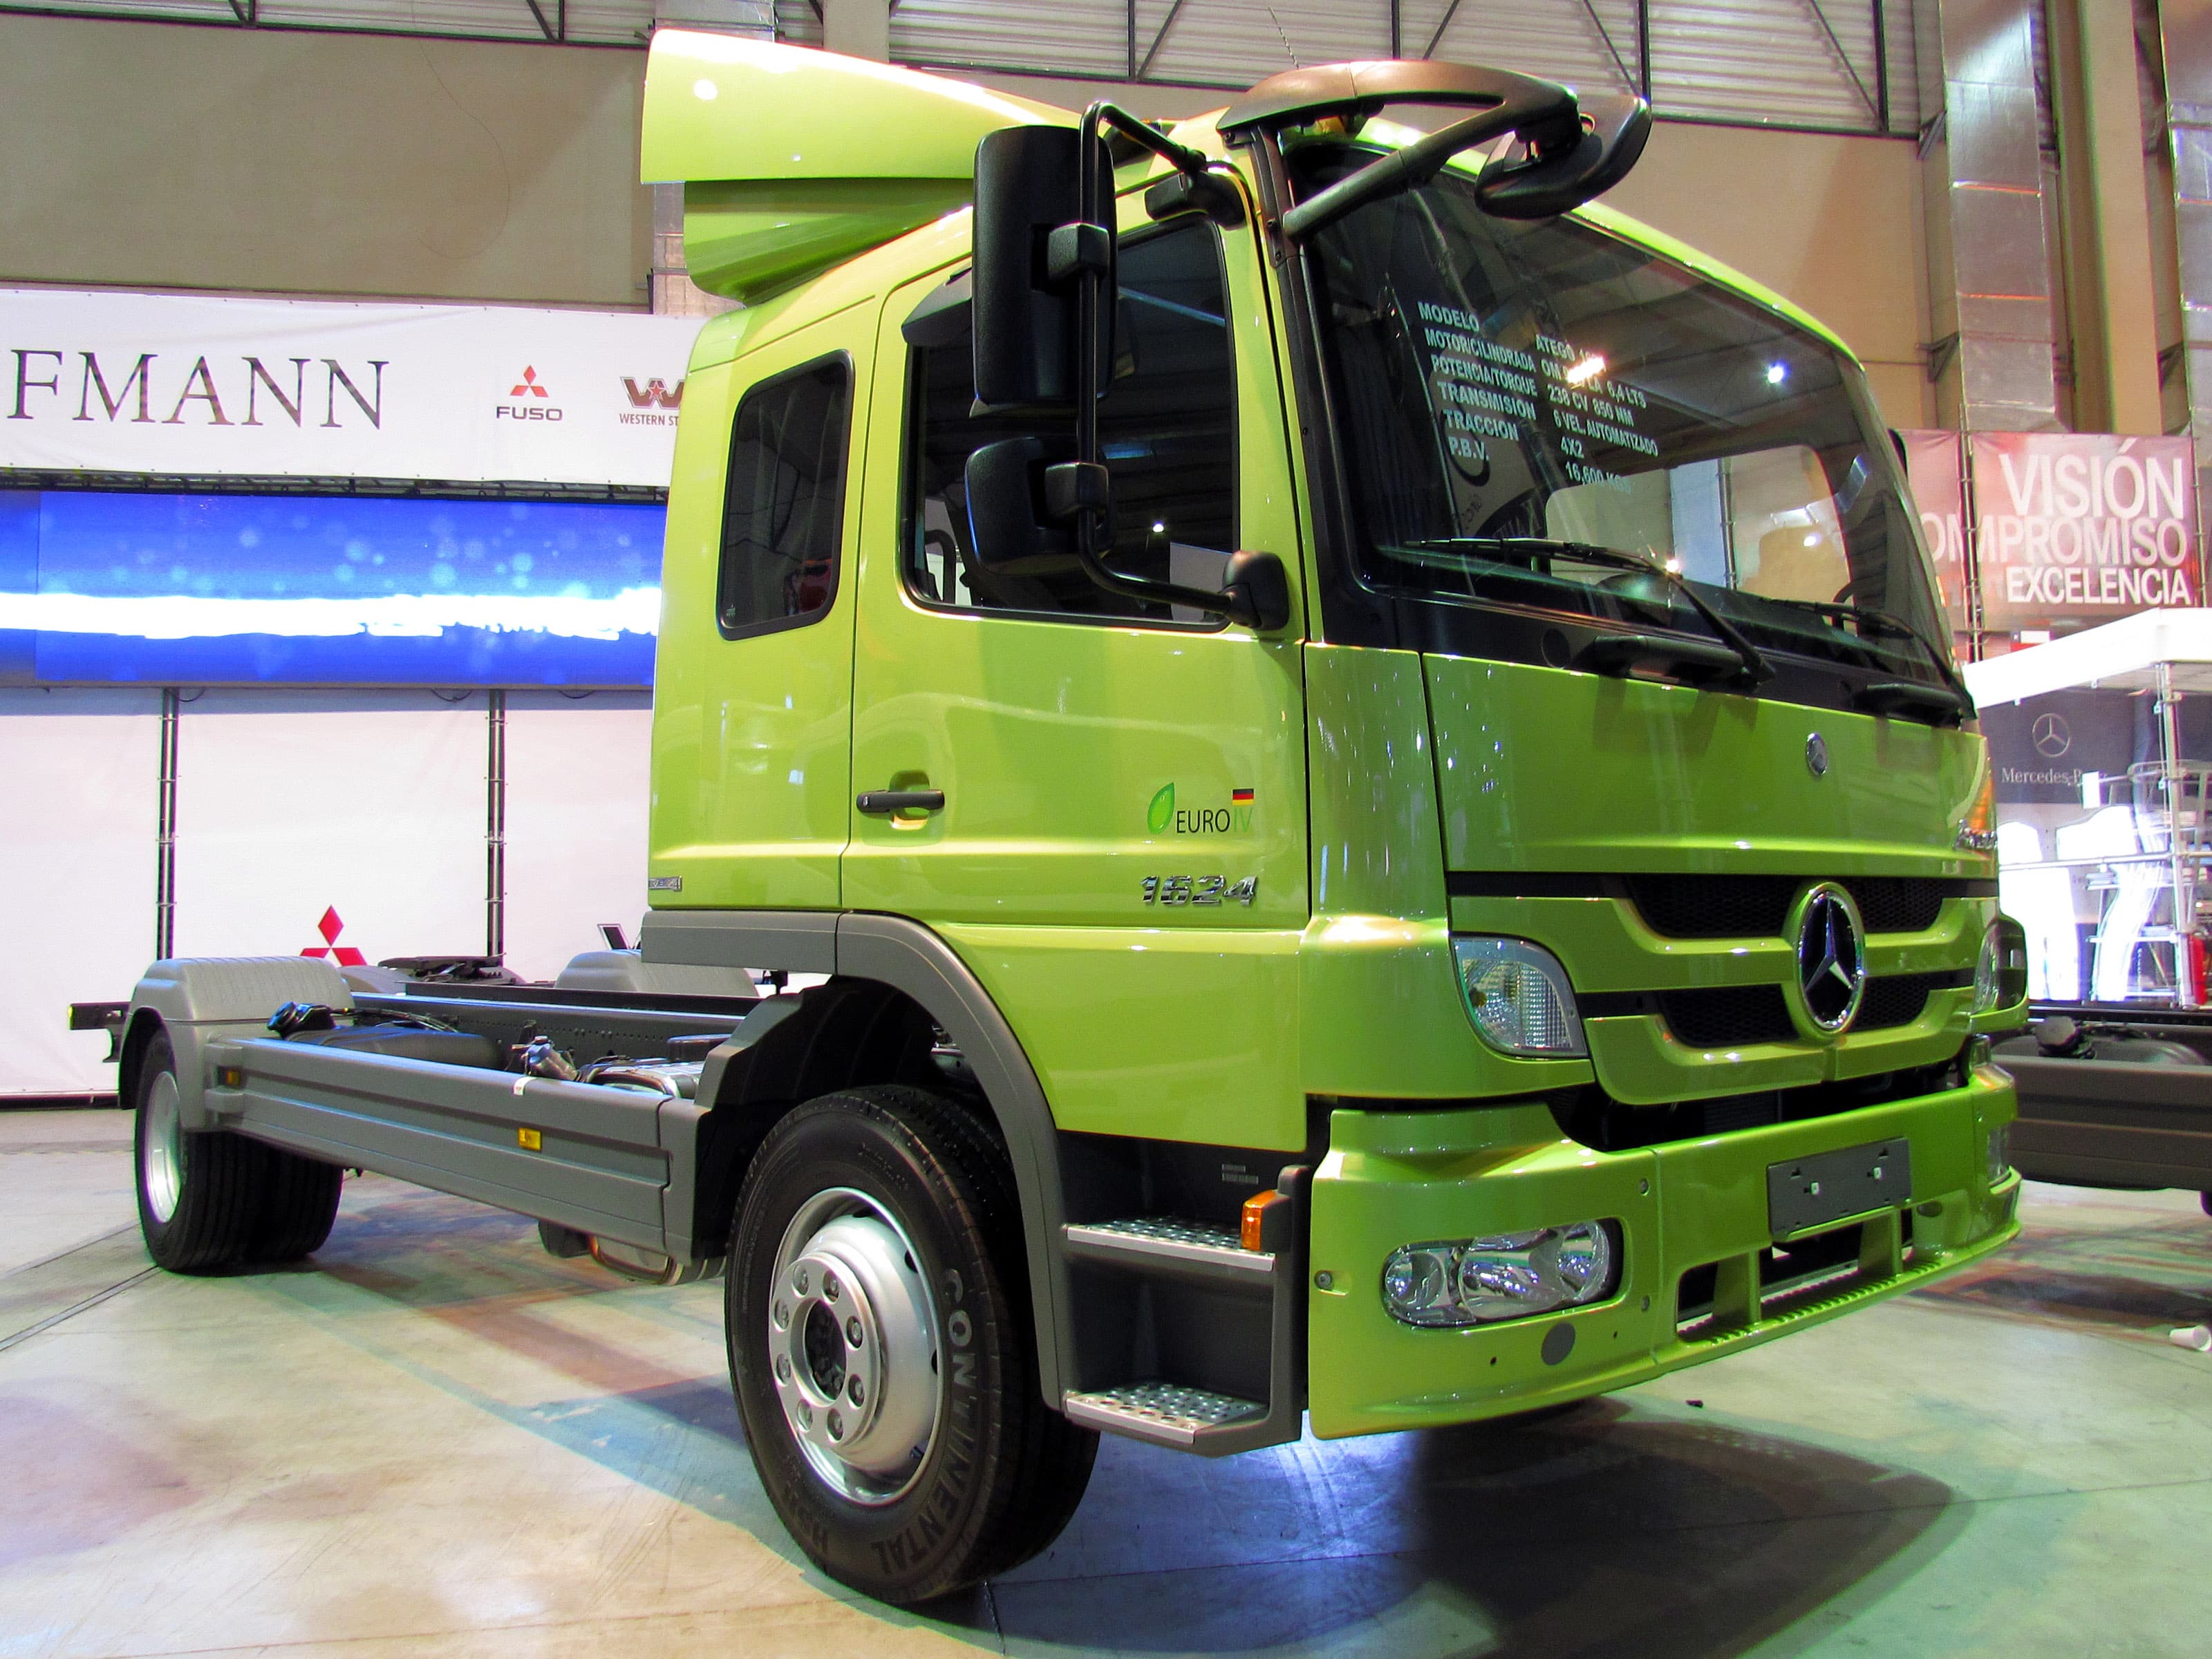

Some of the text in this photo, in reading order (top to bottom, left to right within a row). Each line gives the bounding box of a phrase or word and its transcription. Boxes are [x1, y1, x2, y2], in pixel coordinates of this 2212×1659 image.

[1418, 301, 1479, 332] MODELO
[1535, 334, 1575, 362] ATEGO
[1425, 328, 1536, 373] MOTOR/CILINDRADA
[1625, 386, 1647, 409] LTS
[7, 349, 389, 429] FMANN
[1431, 354, 1537, 397] POTENCIA/TORQUE
[1547, 384, 1571, 406] 238
[1572, 392, 1588, 411] CV
[1592, 398, 1614, 420] 850
[1615, 406, 1634, 427] NM
[496, 406, 563, 421] FUSO
[619, 413, 665, 426] WESTERN
[1437, 382, 1537, 420] TRANSMISION
[1553, 409, 1562, 428] 6
[1586, 420, 1658, 457] AUTOMATIZADO
[1443, 409, 1584, 459] TRACCION 4X2
[1448, 436, 1490, 461] P.B.V.
[1999, 438, 2184, 519] VISIÓN
[2007, 567, 2191, 605] EXCELENCIA
[1177, 807, 1253, 833] EURO IV
[1141, 875, 1257, 906] 1624
[870, 1268, 976, 1575] CONTINENTAL
